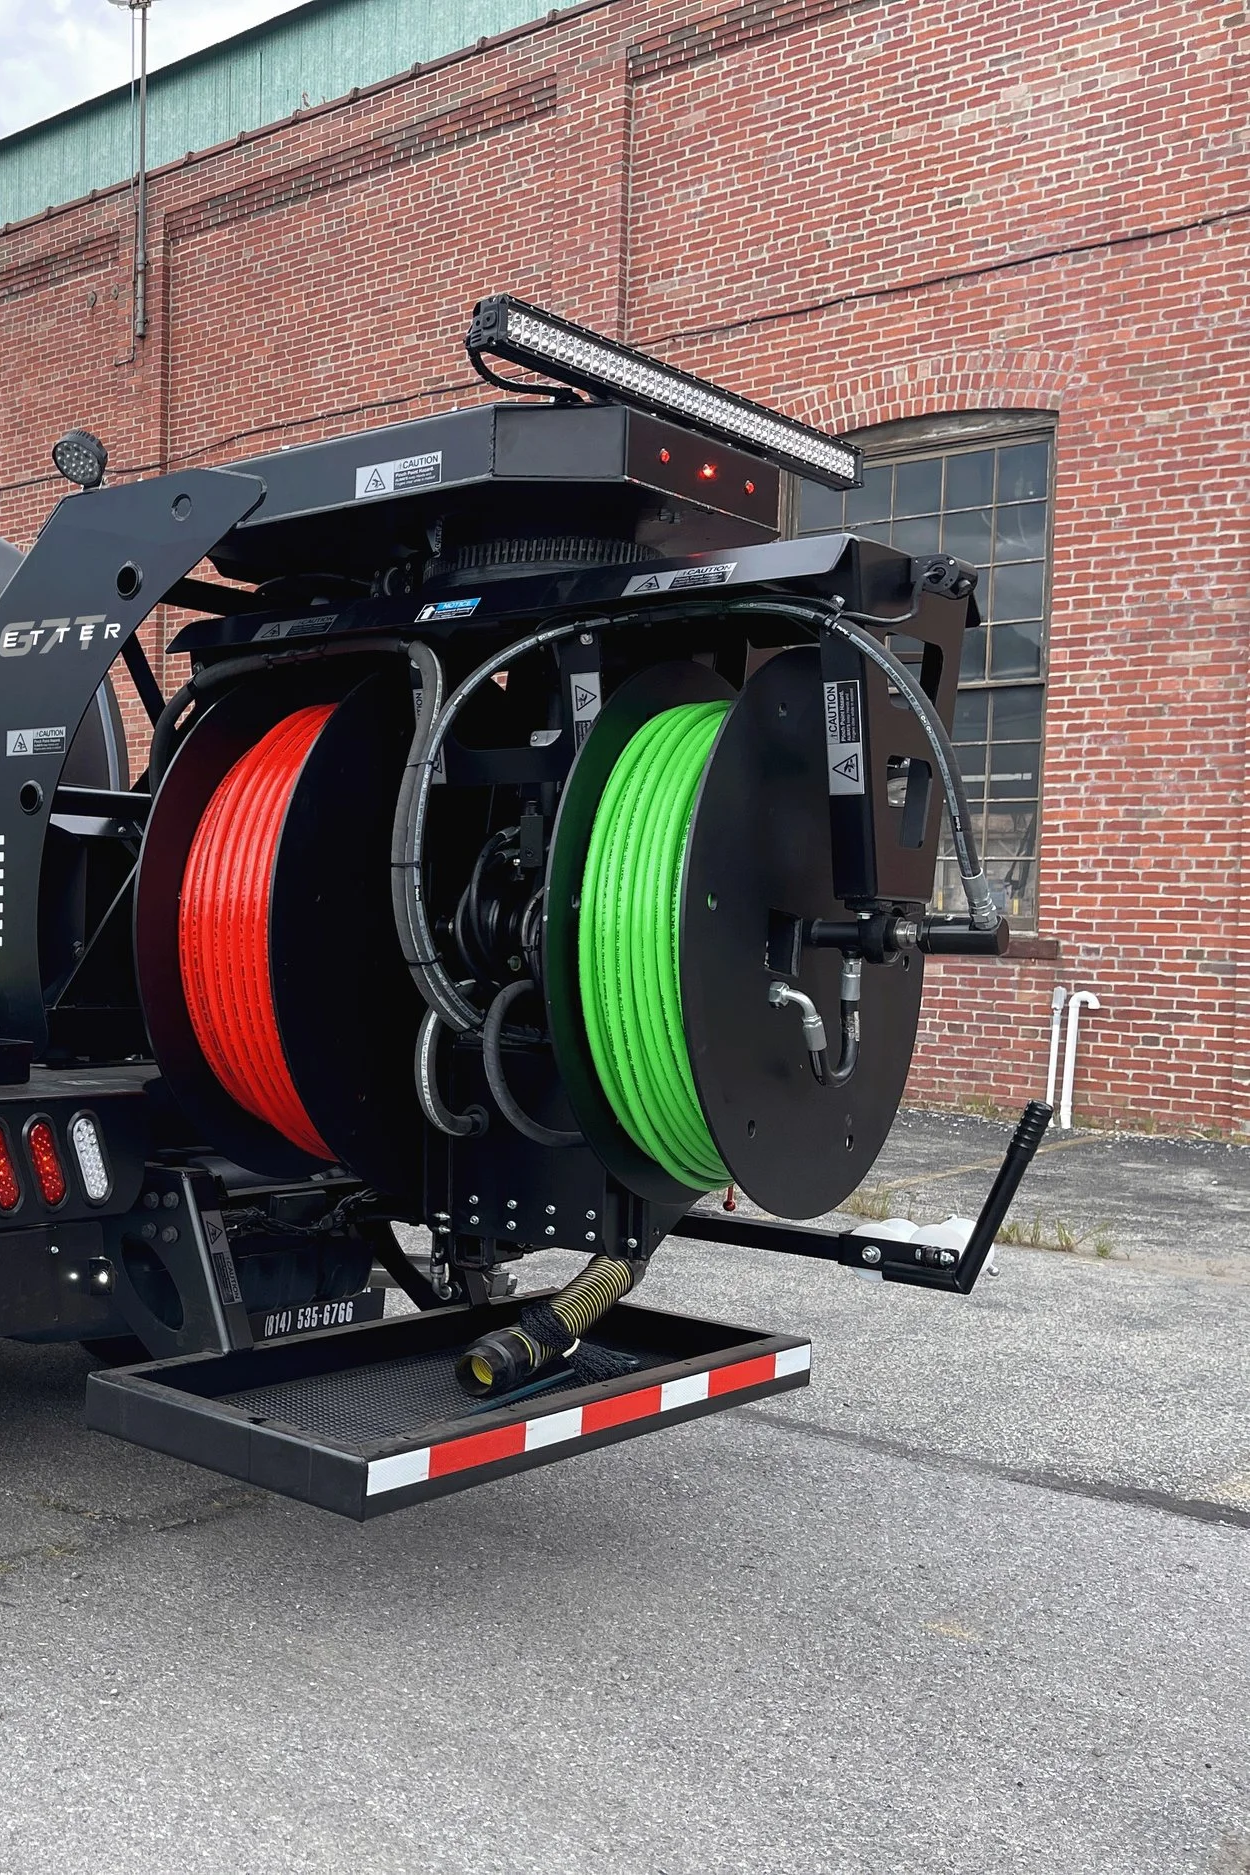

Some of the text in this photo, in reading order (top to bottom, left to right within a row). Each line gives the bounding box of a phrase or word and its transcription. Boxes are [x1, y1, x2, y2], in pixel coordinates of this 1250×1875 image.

[403, 455, 439, 469] CAUTION
[686, 564, 732, 576] CAUTION
[442, 600, 472, 610] NOTICE
[302, 616, 335, 625] CAUTION
[826, 686, 838, 733] CAUTION
[38, 729, 64, 738] CAUTION
[226, 1261, 241, 1299] CAUTION
[264, 1301, 354, 1337] (814) 535-6766
